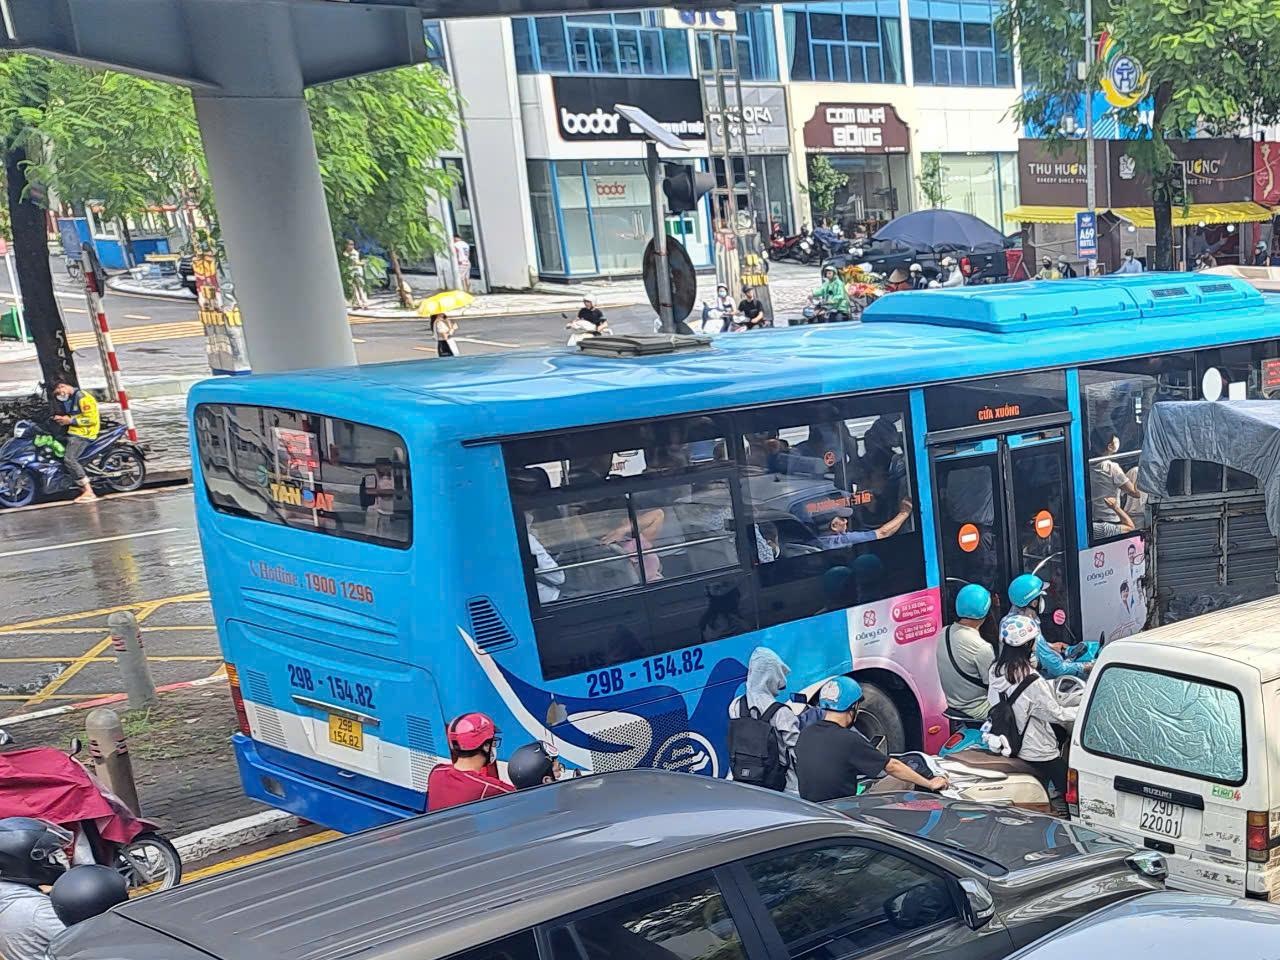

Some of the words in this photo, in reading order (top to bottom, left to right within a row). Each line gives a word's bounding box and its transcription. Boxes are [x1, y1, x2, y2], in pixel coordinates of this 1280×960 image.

[561, 107, 620, 134] bodor
[1028, 163, 1052, 175] THU
[596, 181, 626, 196] bodor
[1080, 229, 1094, 240] A69
[305, 573, 336, 596] 1900
[340, 580, 374, 604] 1296
[587, 667, 624, 698] 29B
[643, 648, 705, 683] 154.82
[287, 664, 314, 692] 29B
[330, 674, 376, 710] 154.82
[337, 717, 353, 733] 29B
[333, 731, 359, 748] 154.82
[1143, 786, 1172, 799] SUZUKI
[1140, 812, 1179, 836] 220.01
